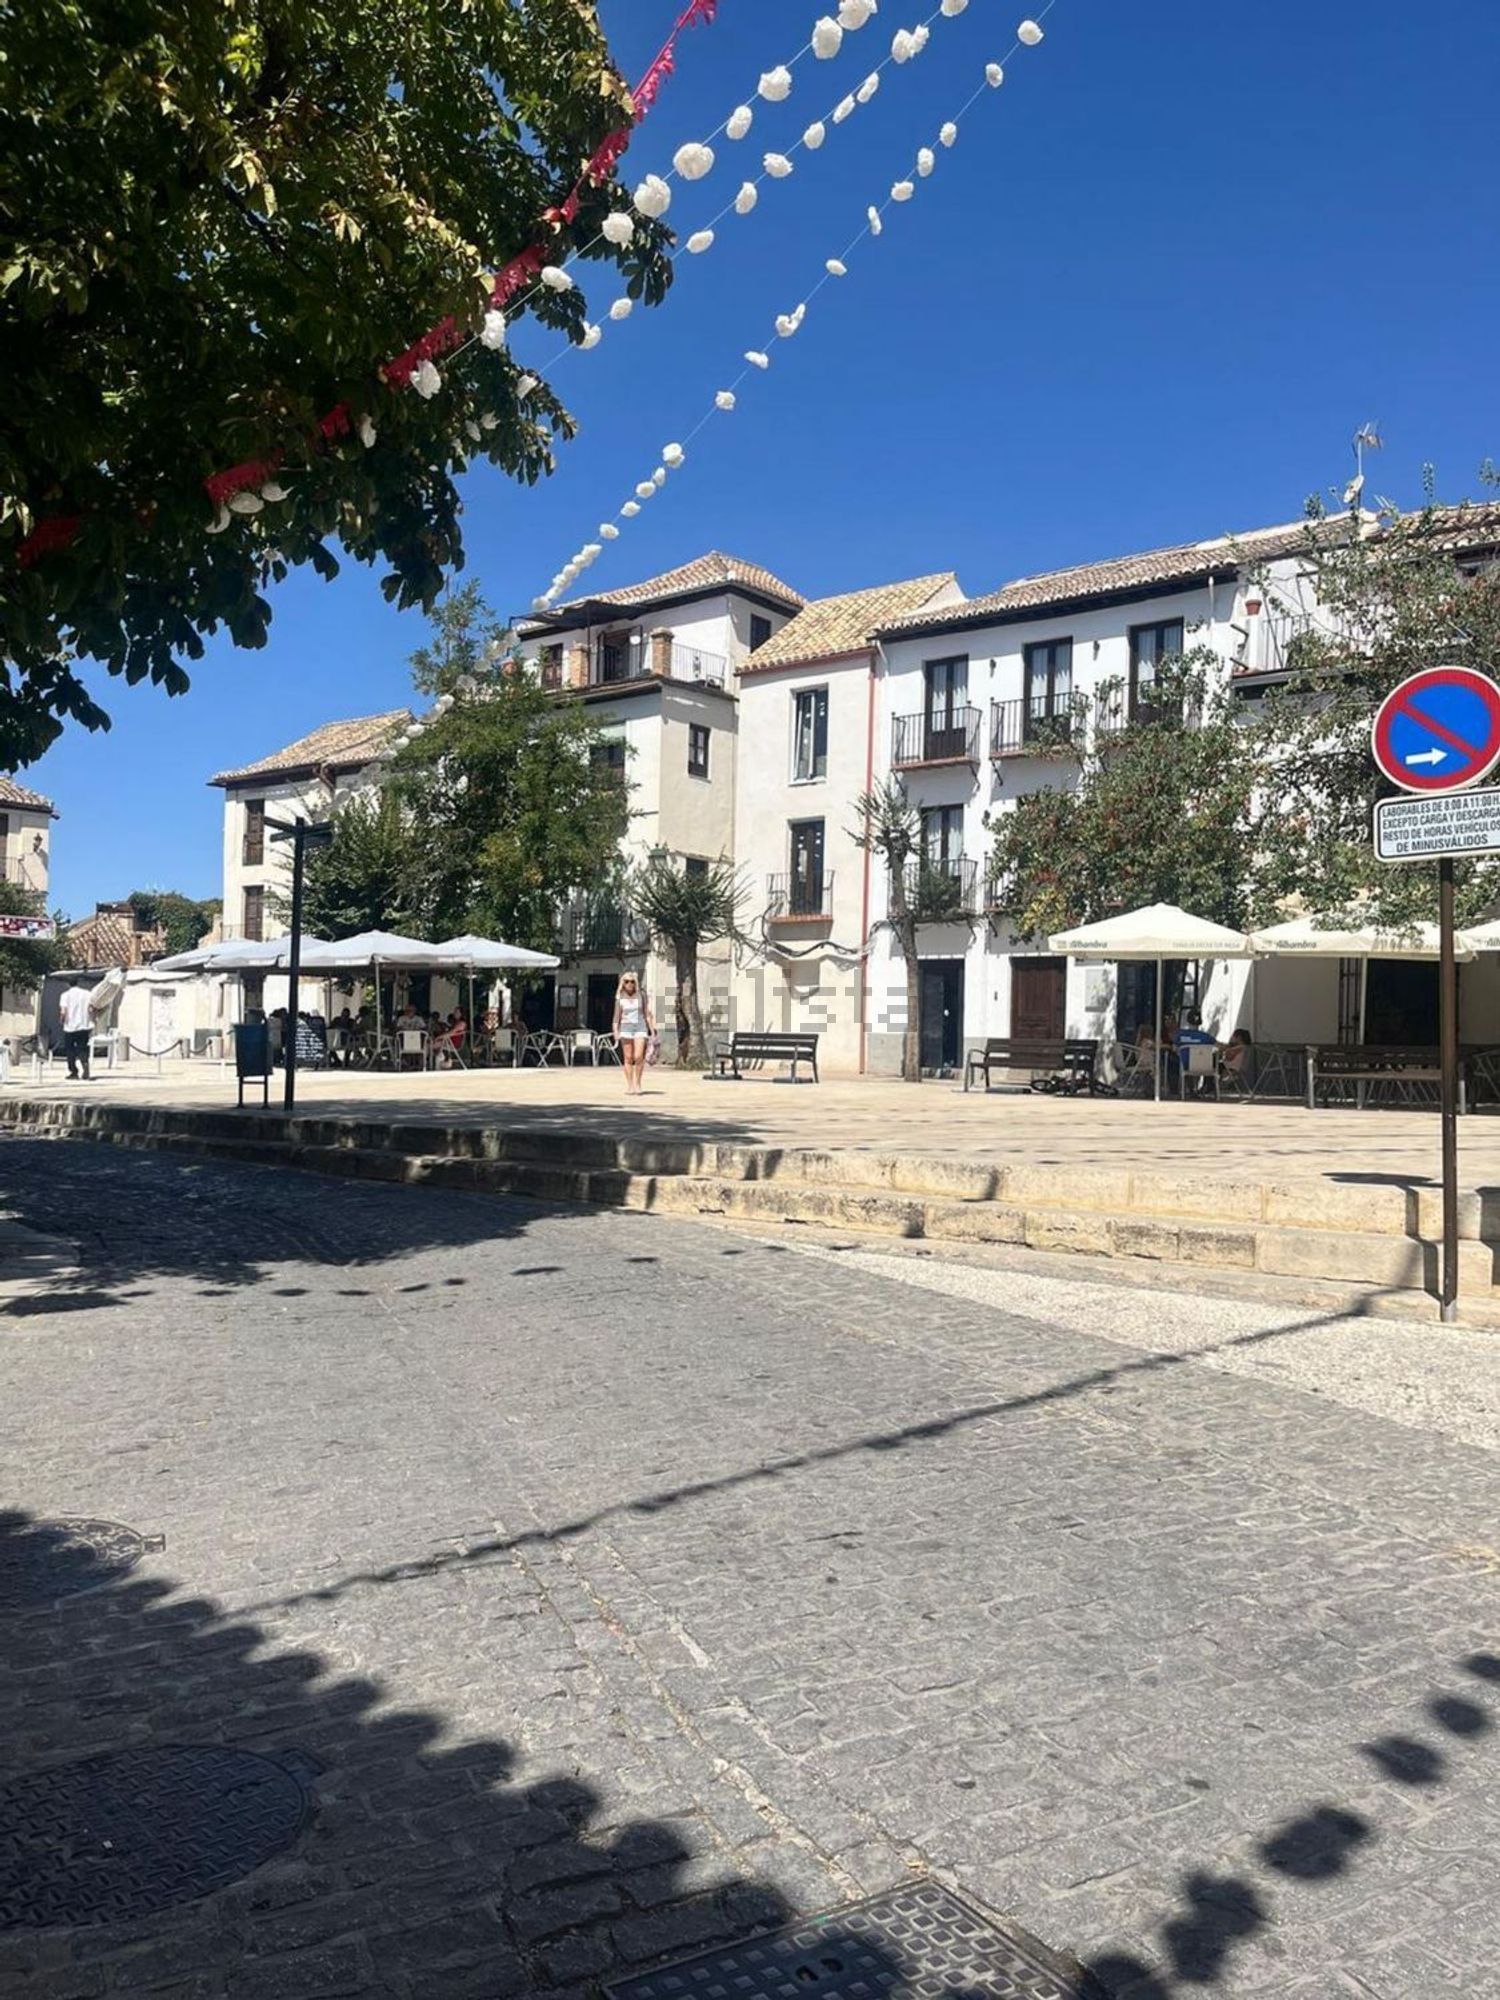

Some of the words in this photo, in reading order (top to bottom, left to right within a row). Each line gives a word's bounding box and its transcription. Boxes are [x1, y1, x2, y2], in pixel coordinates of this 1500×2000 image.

[1382, 803, 1431, 818] LABORABLES
[1432, 801, 1442, 812] DE
[1463, 798, 1469, 808] A
[1382, 817, 1418, 830] EXCEPTO
[1420, 812, 1448, 825] CARGA
[1448, 812, 1454, 821] Y
[1382, 829, 1409, 841] RESTO
[1411, 828, 1421, 839] DE
[1424, 824, 1453, 837] HORAS
[1396, 842, 1409, 853] DE
[1411, 833, 1488, 851] MINUSVÁLIDOS
